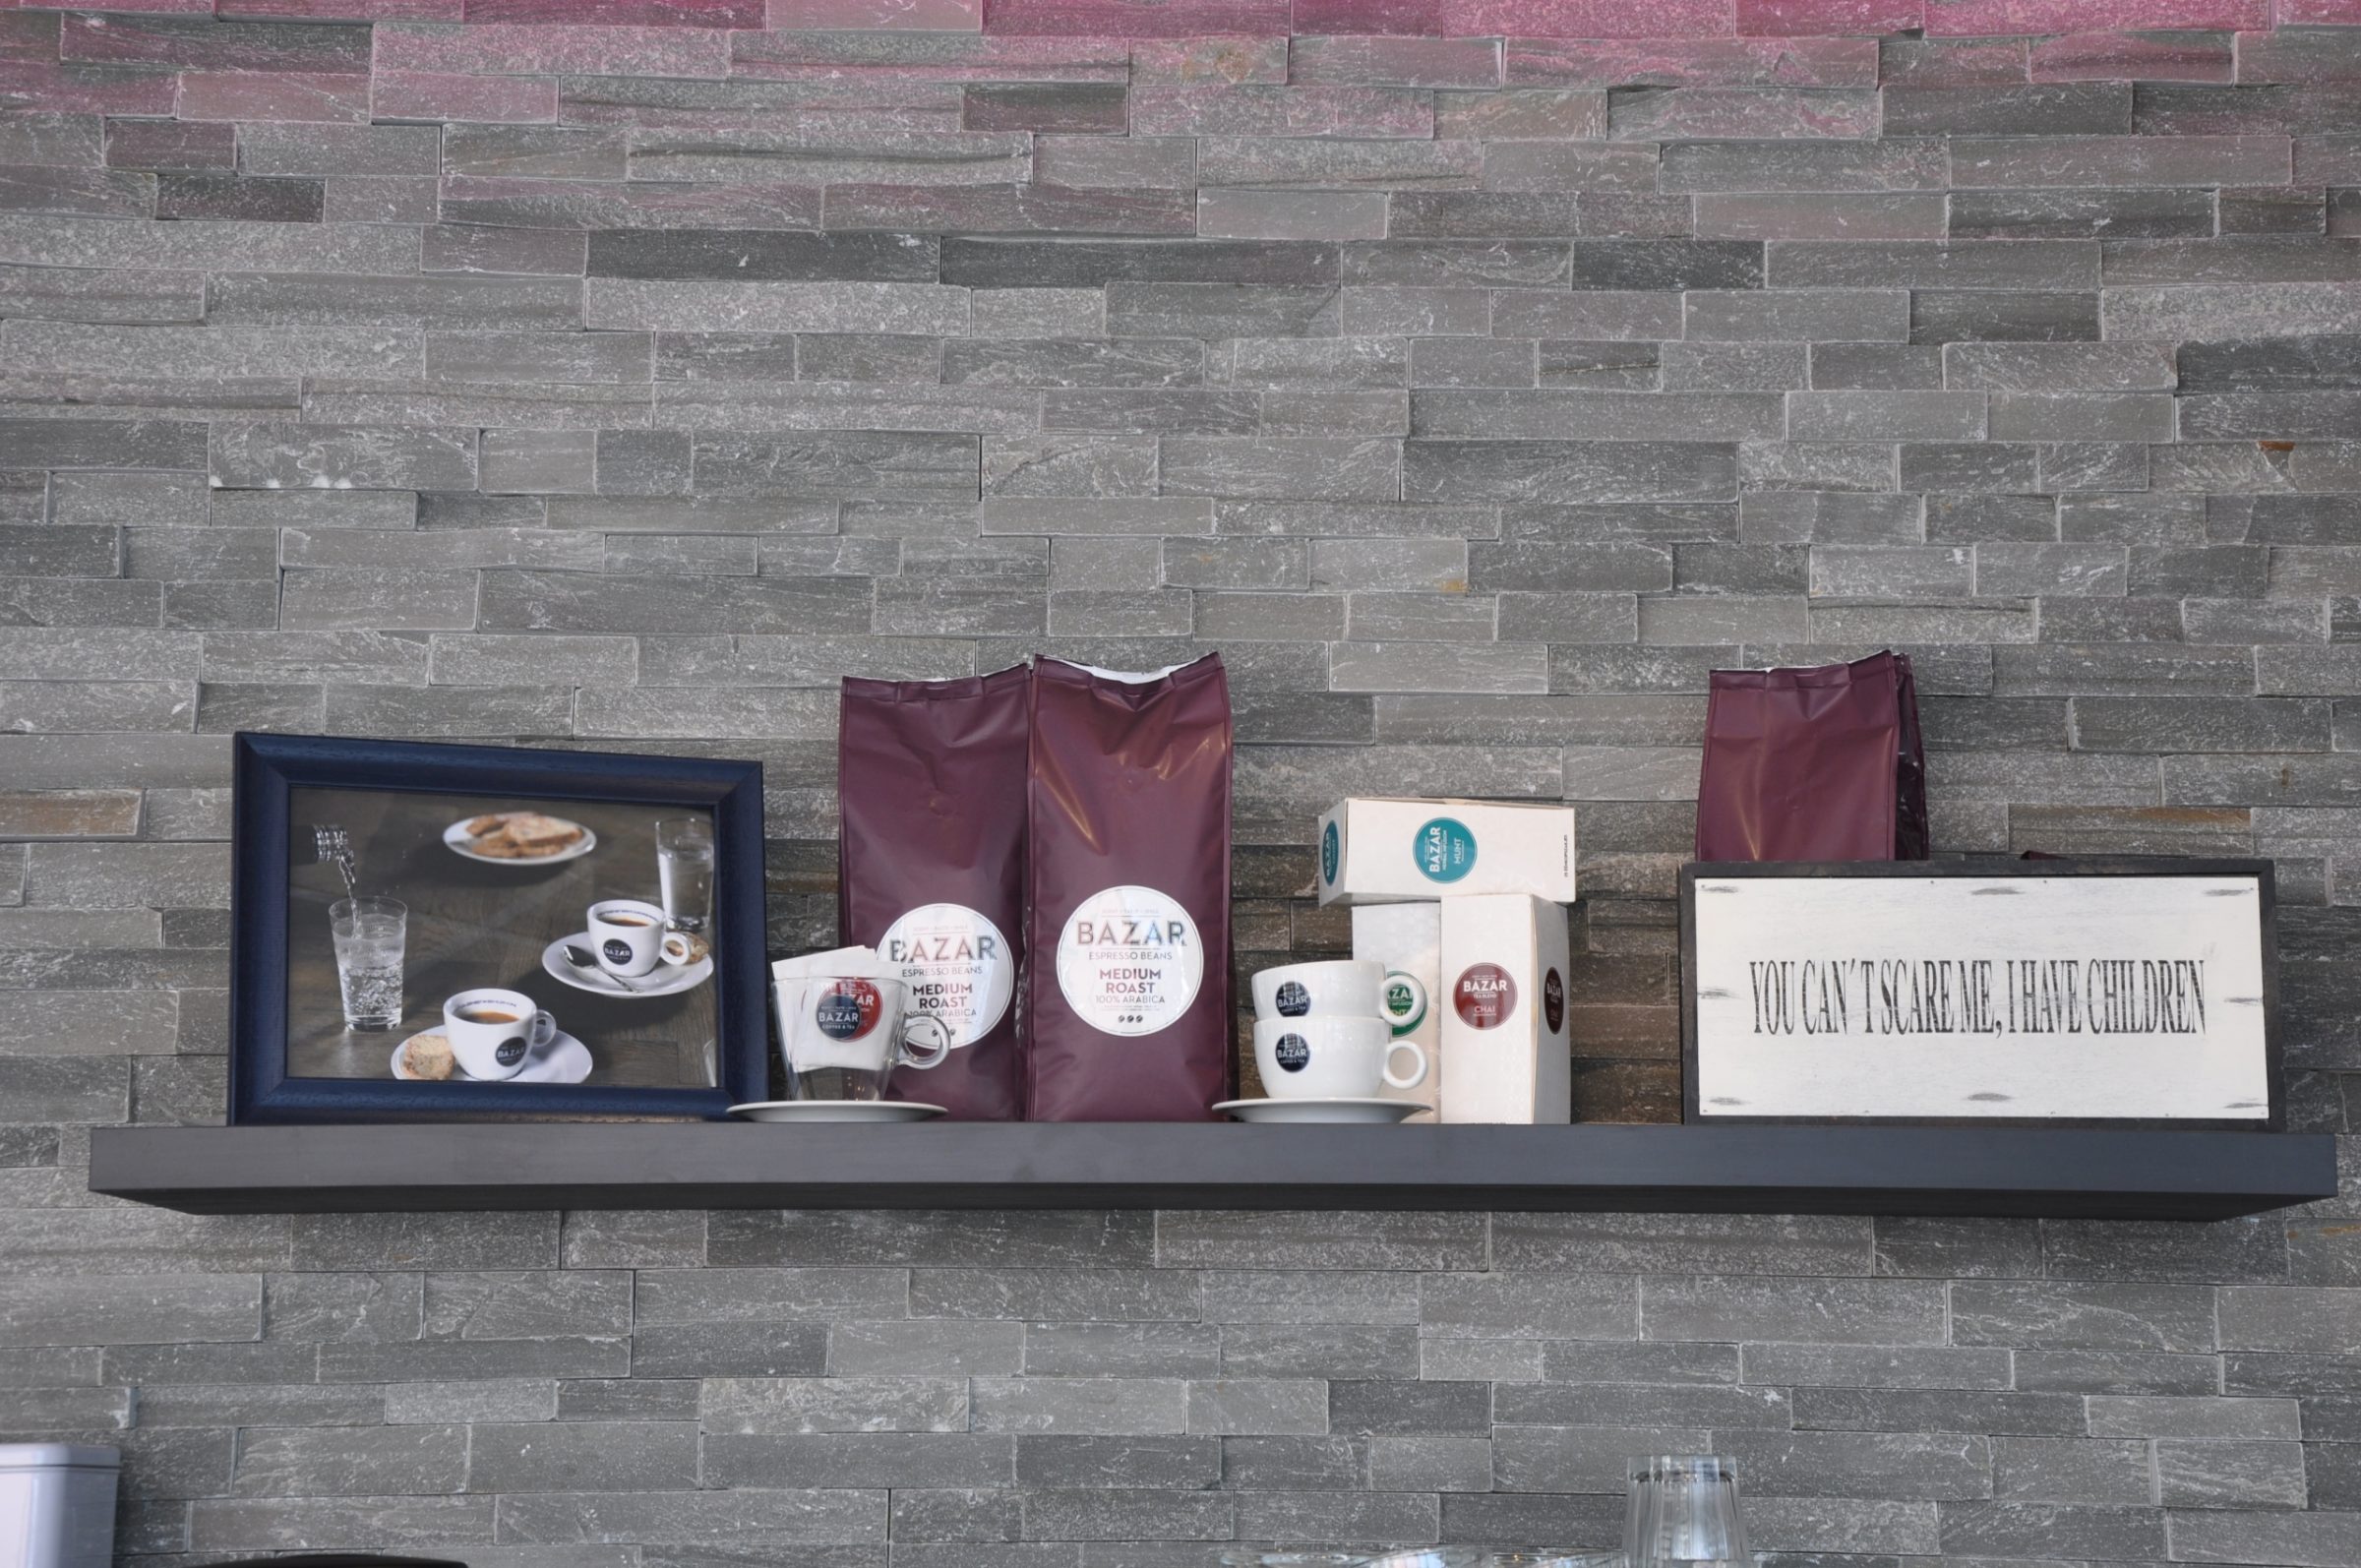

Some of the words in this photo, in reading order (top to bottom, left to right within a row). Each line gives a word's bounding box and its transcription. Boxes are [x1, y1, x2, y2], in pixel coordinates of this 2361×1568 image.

[1429, 826, 1441, 873] BAZAR
[1077, 921, 1187, 946] BAZAR
[889, 935, 998, 963] BAZAR
[1089, 951, 1138, 960] ESPRESSO
[1140, 951, 1173, 960] BEANS
[902, 968, 949, 978] ESPRESSO
[951, 966, 983, 975] BEANS
[1100, 968, 1162, 980] MEDIUM
[912, 984, 973, 995] MEDIUM
[1106, 983, 1156, 994] ROAST
[1463, 979, 1508, 993] BAZAR
[919, 996, 967, 1009] ROAST
[1095, 995, 1120, 1004] 100%
[1122, 995, 1166, 1003] ARABICA
[1277, 995, 1307, 1007] BAZAR
[1749, 959, 1795, 1035] YOU
[1802, 958, 1875, 1035] CAN'T
[1881, 958, 1954, 1035] SCARE
[1959, 960, 2002, 1039] ME,
[2007, 960, 2017, 1033] I
[2021, 960, 2082, 1035] HAVE
[2087, 958, 2206, 1035] CHILDREN
[818, 1012, 859, 1023] BAZAR
[936, 1008, 977, 1018] ARABICA
[1277, 1049, 1306, 1058] BAZAR
